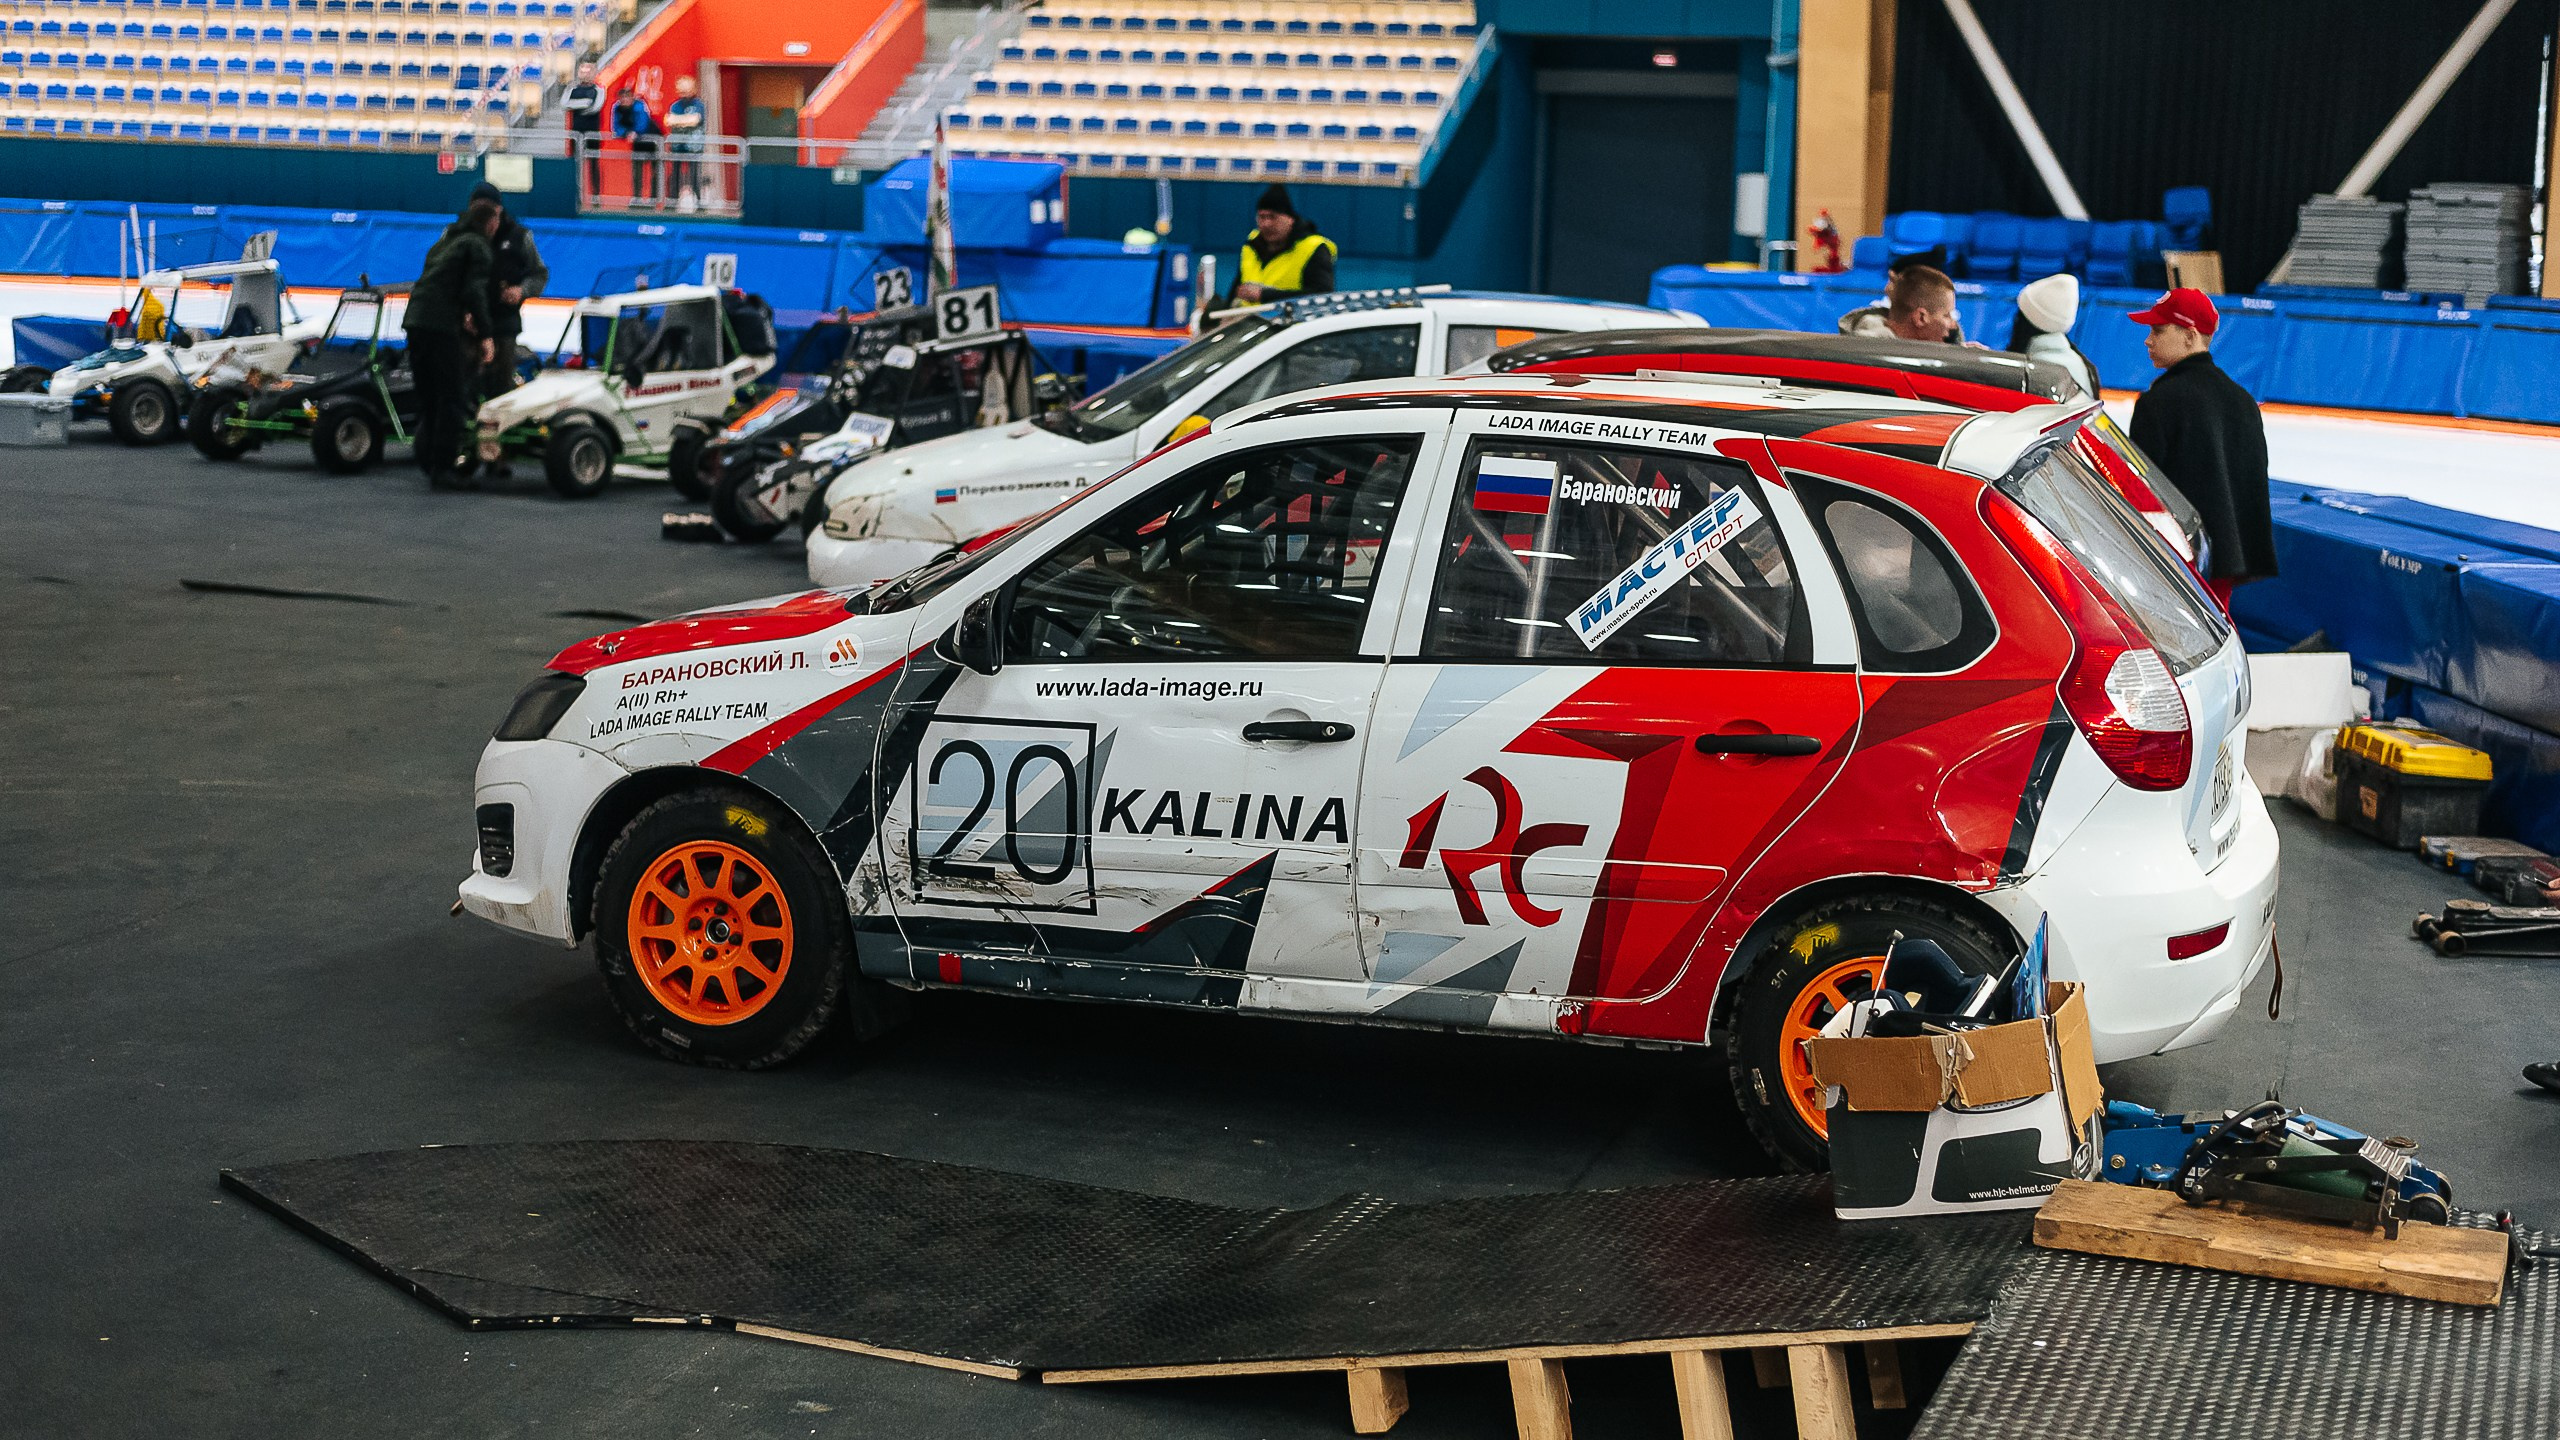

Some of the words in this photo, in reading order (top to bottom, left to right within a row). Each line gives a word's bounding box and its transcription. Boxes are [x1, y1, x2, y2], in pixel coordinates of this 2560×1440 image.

[710, 261, 734, 283] 10
[876, 269, 911, 309] 23
[942, 291, 993, 333] 81
[1488, 414, 1533, 431] LADA
[1538, 418, 1595, 436] IMAGE
[1598, 423, 1654, 441] RALLY
[1657, 428, 1707, 447] TEAM
[1559, 474, 1682, 509] Барановский
[1684, 514, 1744, 569] СПОРТ
[1579, 492, 1740, 633] МАСТЕР
[621, 650, 784, 690] БАРАНОВСКИЙ
[789, 652, 810, 670] Л.
[1036, 678, 1263, 701] www.lada-image.ru
[654, 690, 689, 705] Rh+
[590, 717, 623, 740] LADA
[626, 710, 673, 731] IMAGE
[674, 705, 722, 725] RALLY
[725, 702, 768, 720] TEAM
[929, 739, 1078, 886] 20
[1099, 787, 1349, 844] KALINA
